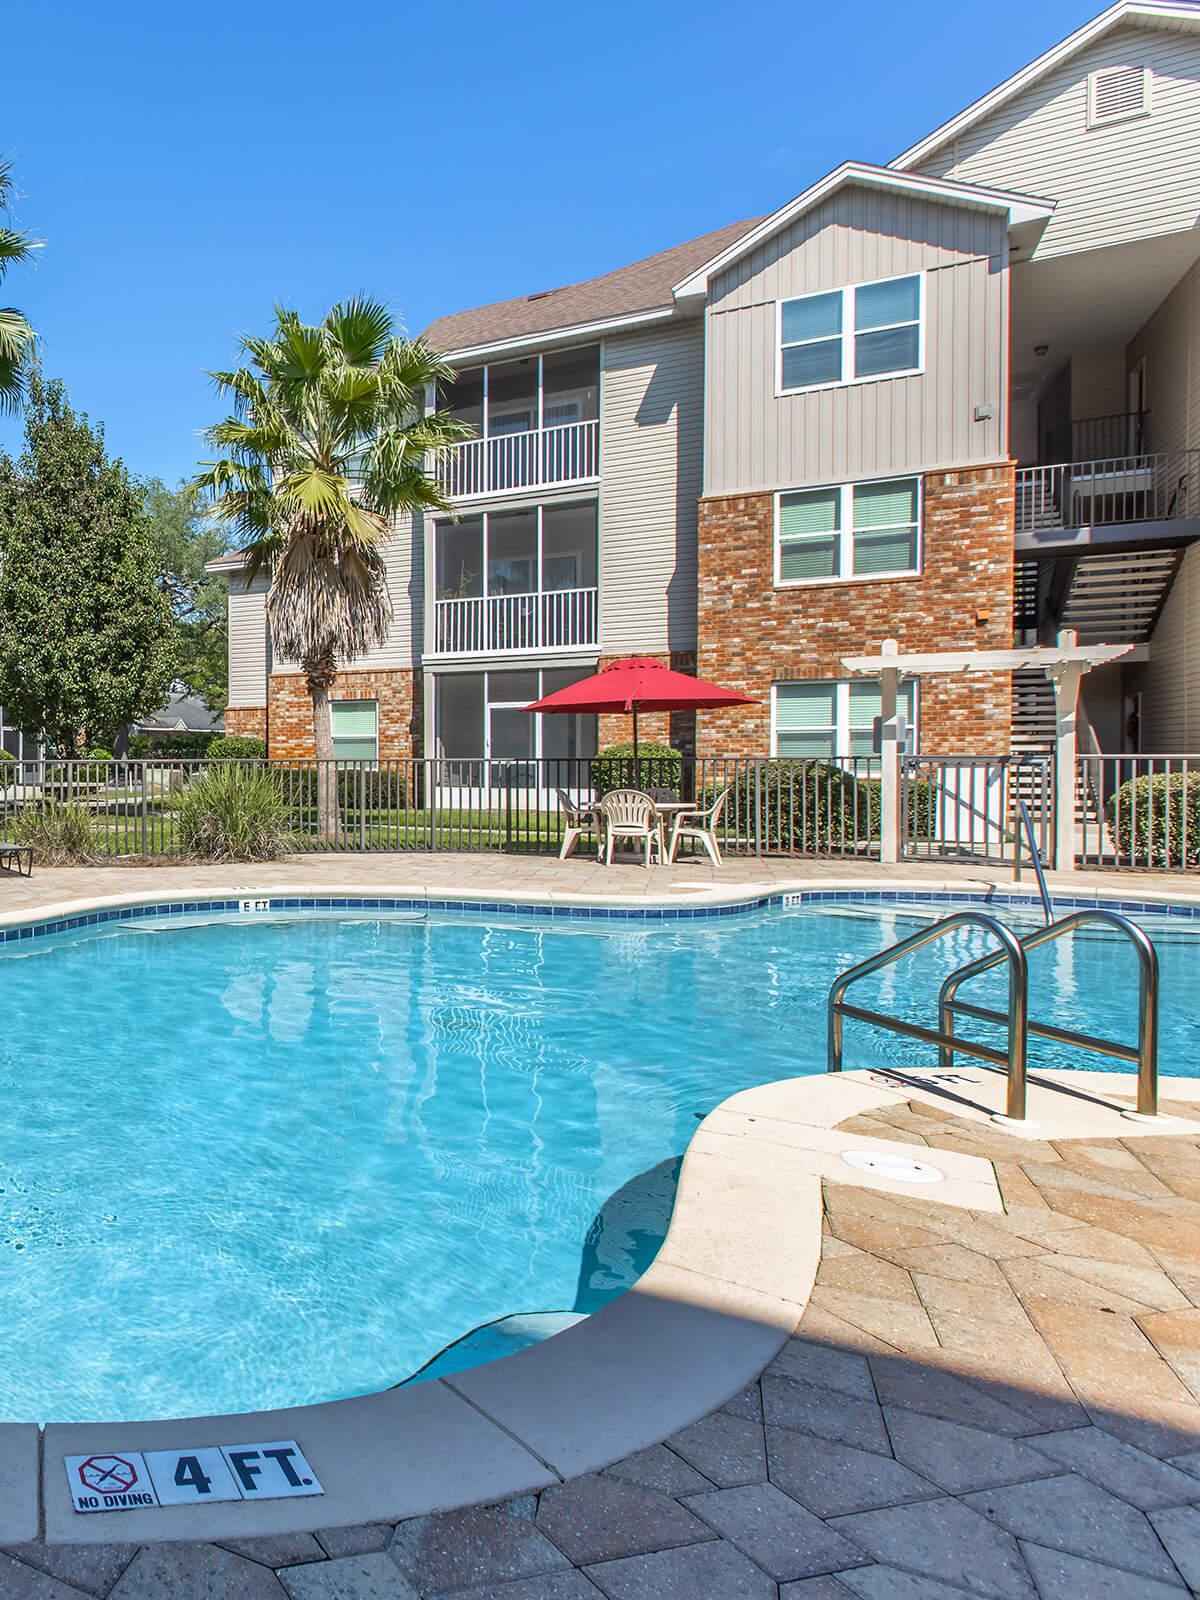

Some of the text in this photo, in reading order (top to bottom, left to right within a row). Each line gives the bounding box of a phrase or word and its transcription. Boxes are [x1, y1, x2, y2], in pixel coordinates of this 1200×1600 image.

[174, 1448, 313, 1494] 4 FT.
[78, 1492, 153, 1509] NO DIVING
